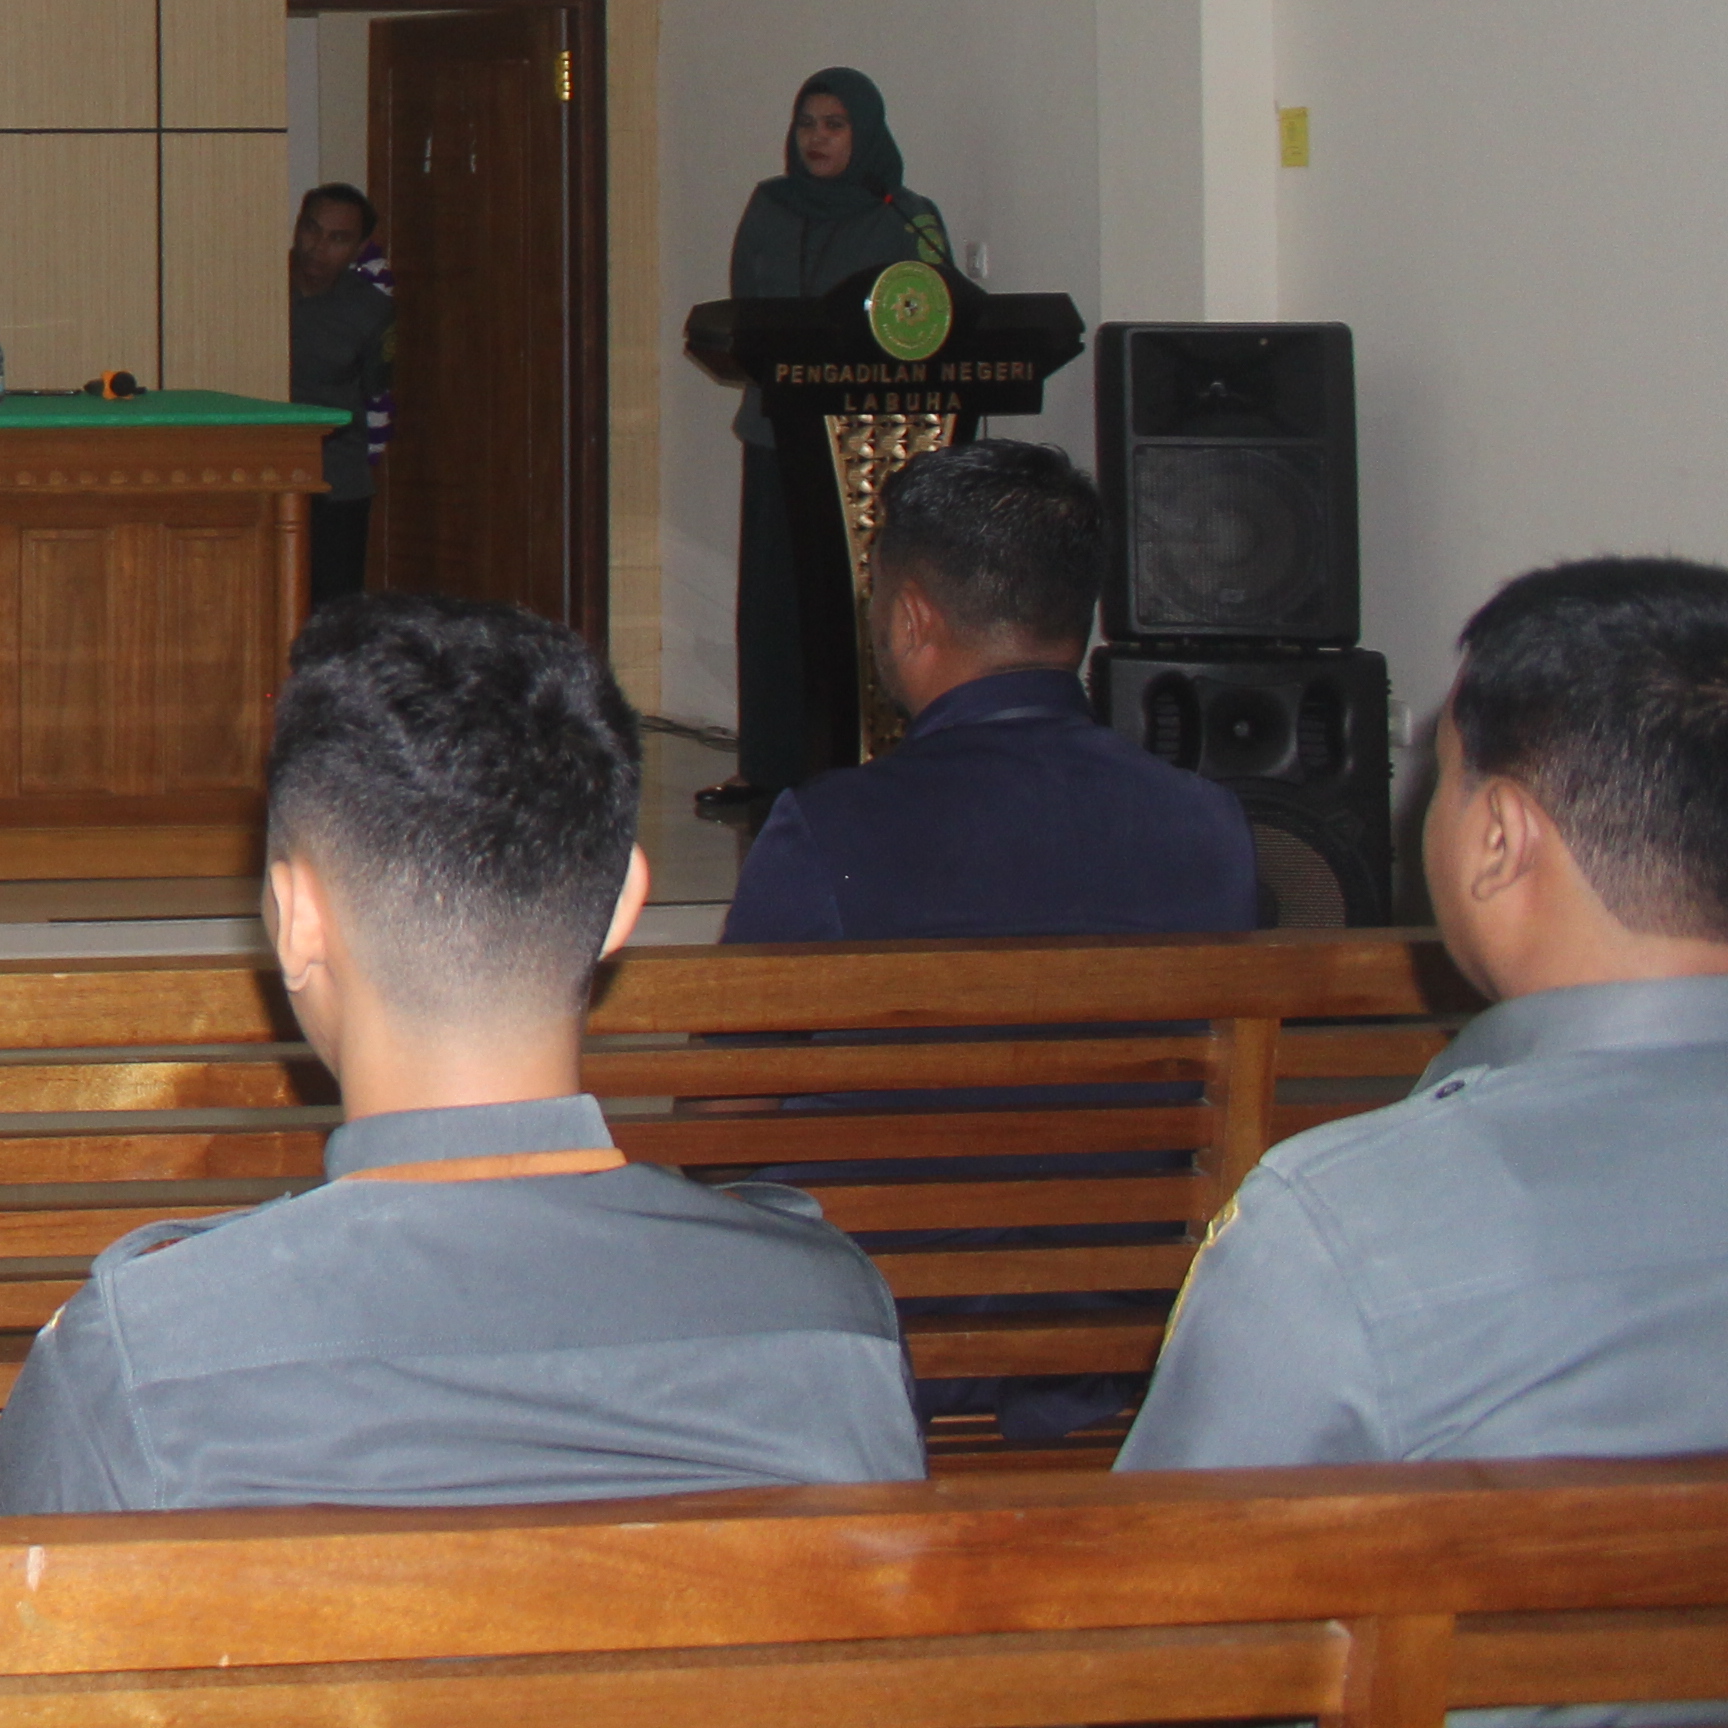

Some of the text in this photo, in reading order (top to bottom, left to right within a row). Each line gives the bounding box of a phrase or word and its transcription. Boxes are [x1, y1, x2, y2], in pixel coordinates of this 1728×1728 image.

[775, 361, 1034, 384] PENGADILAN NEGERI
[844, 391, 962, 413] LABUHA
